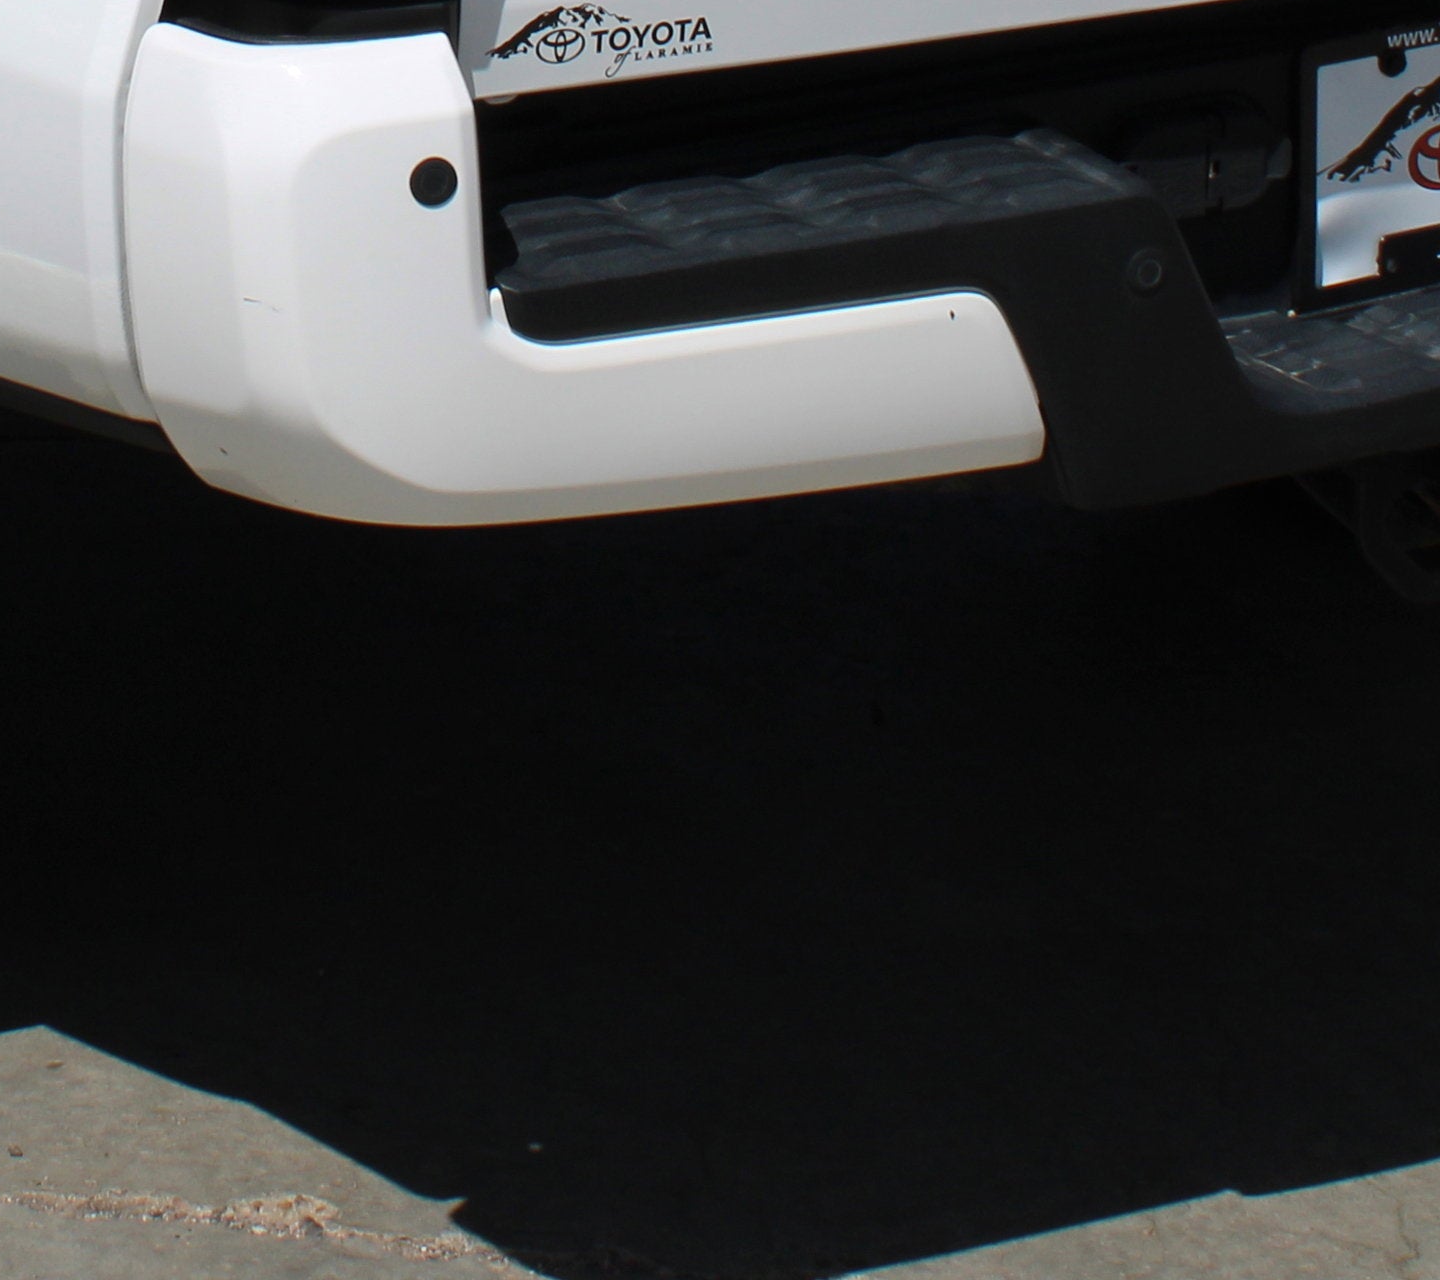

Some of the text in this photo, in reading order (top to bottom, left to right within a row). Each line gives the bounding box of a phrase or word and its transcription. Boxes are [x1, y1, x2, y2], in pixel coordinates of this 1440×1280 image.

[590, 16, 712, 54] TOYOTA
[604, 42, 714, 78] of LARAMIE
